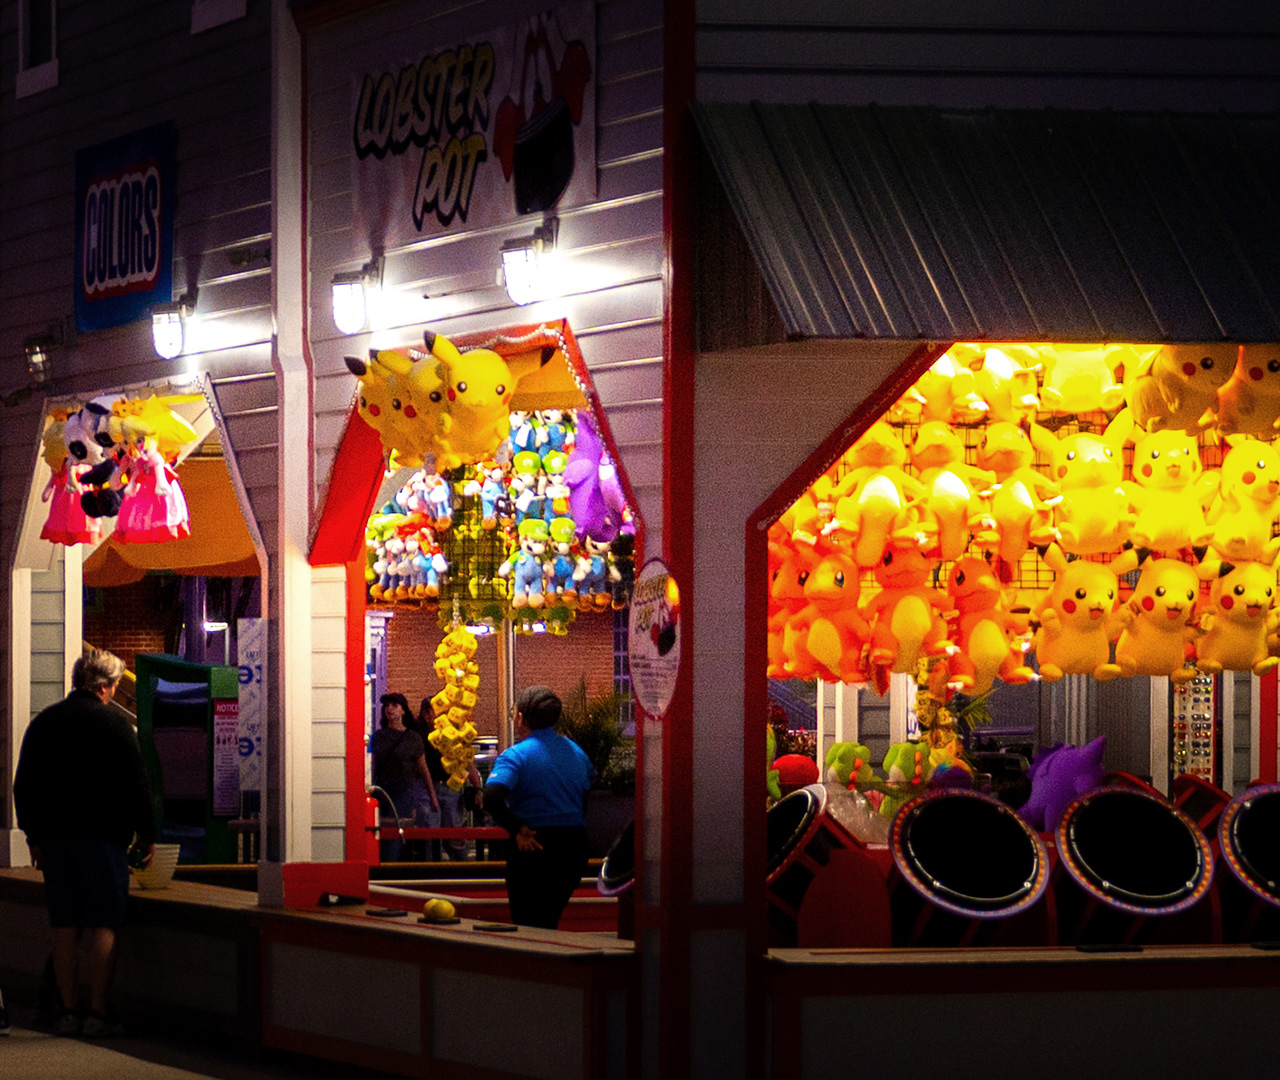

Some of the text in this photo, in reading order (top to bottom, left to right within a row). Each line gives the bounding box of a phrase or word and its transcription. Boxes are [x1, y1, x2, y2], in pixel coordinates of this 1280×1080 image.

[355, 41, 495, 160] LOBSTER
[85, 172, 159, 289] COLORS
[413, 133, 487, 231] POT
